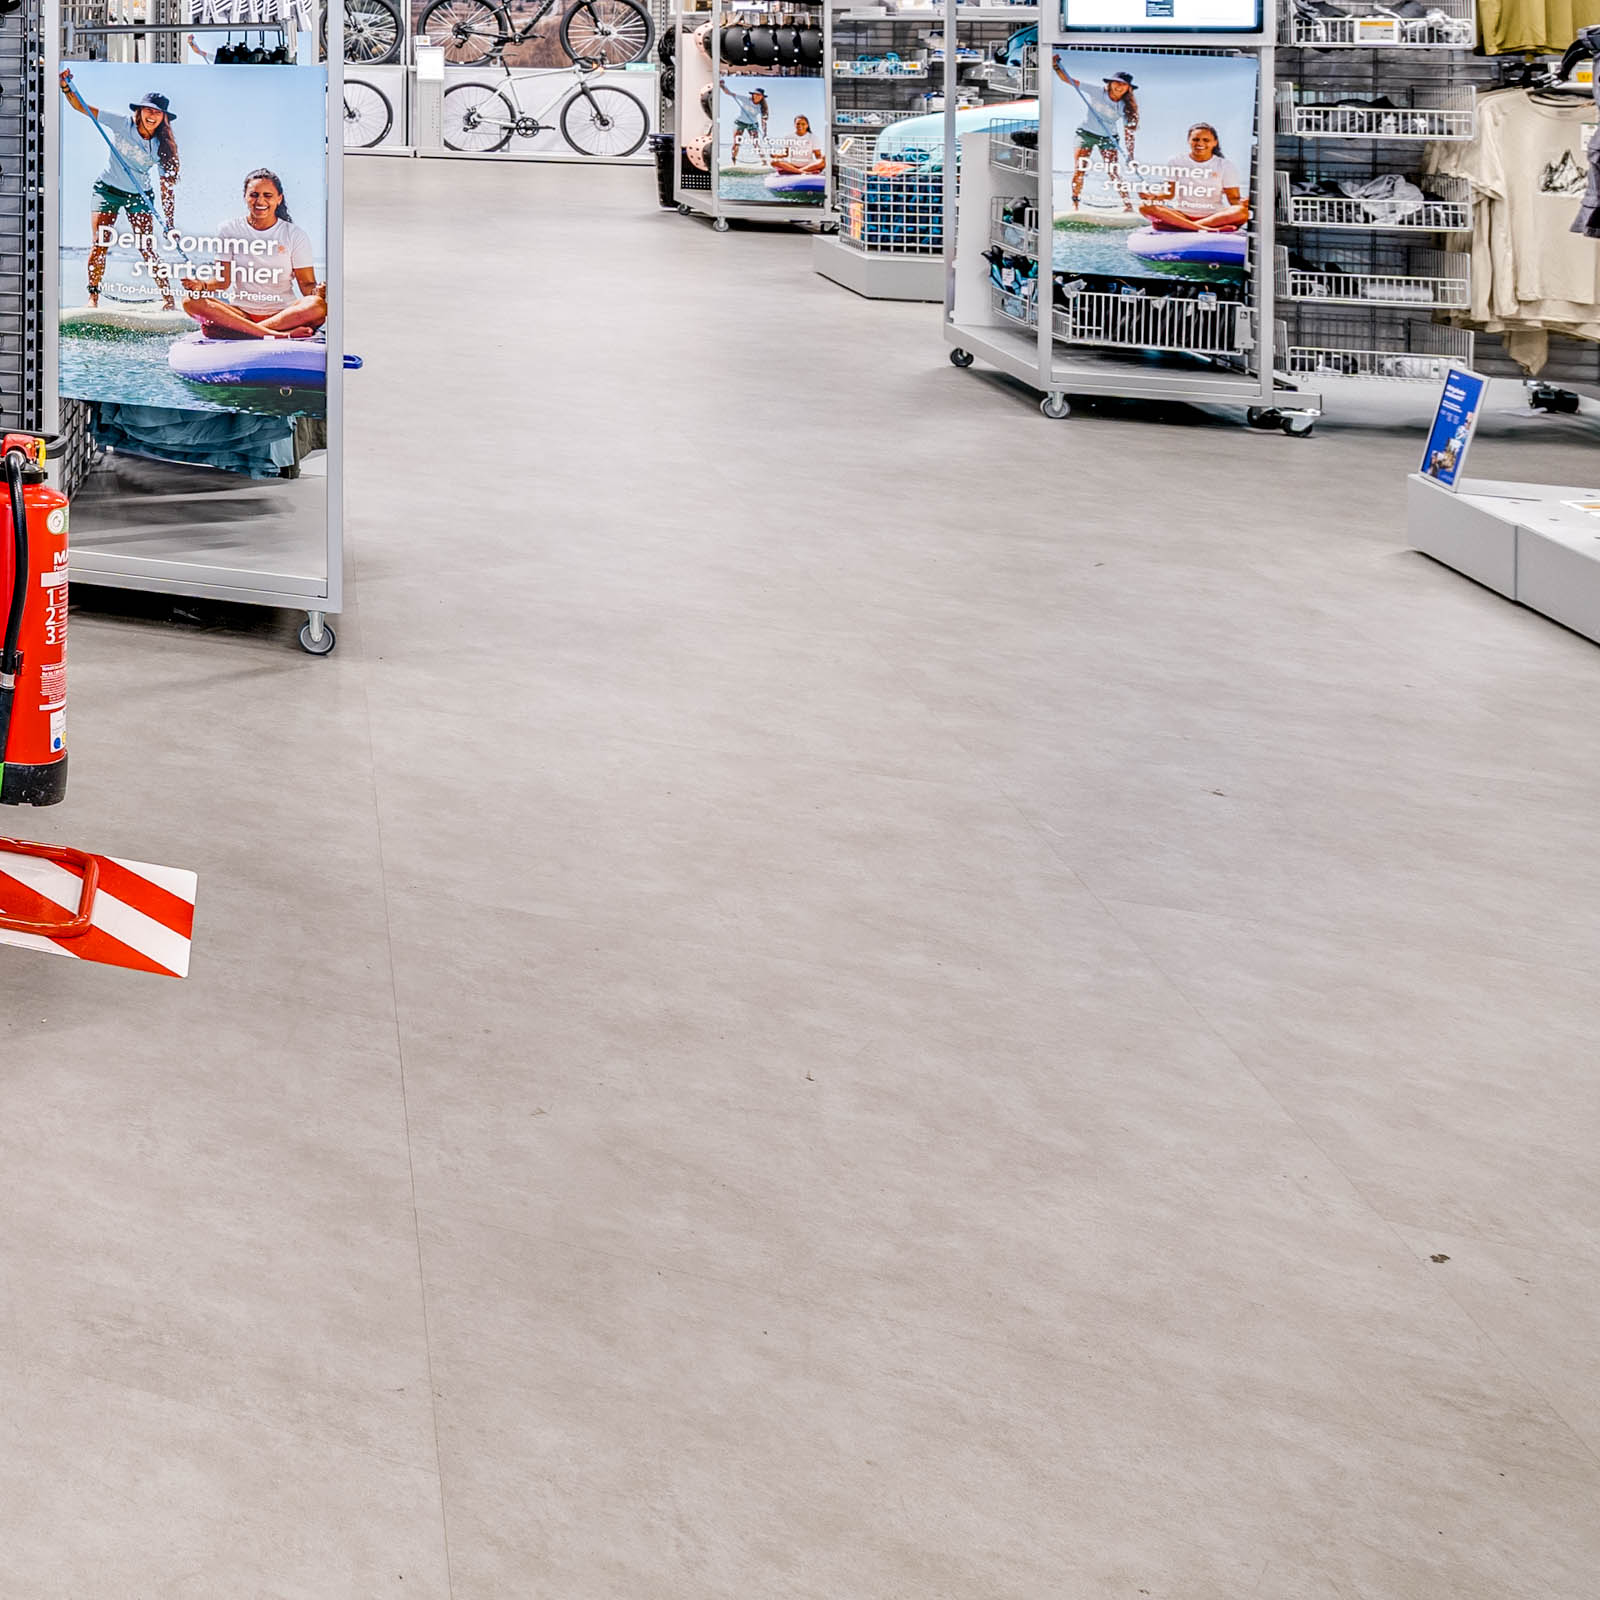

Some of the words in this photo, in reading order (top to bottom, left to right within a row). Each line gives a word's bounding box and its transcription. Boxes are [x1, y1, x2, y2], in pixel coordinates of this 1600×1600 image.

[1078, 156, 1121, 173] Dein
[1126, 160, 1213, 179] Sommer
[1102, 179, 1172, 195] startet
[1175, 181, 1216, 198] hier
[99, 225, 157, 251] Dein
[162, 229, 278, 256] Sommer
[131, 258, 225, 283] startet
[230, 261, 284, 285] hier
[98, 282, 114, 292] Mit
[116, 284, 200, 300] Top-Ausrüstung
[201, 289, 215, 299] zu
[216, 290, 284, 302] Top-Preisen.
[45, 607, 55, 626] 2
[45, 626, 55, 645] 3
